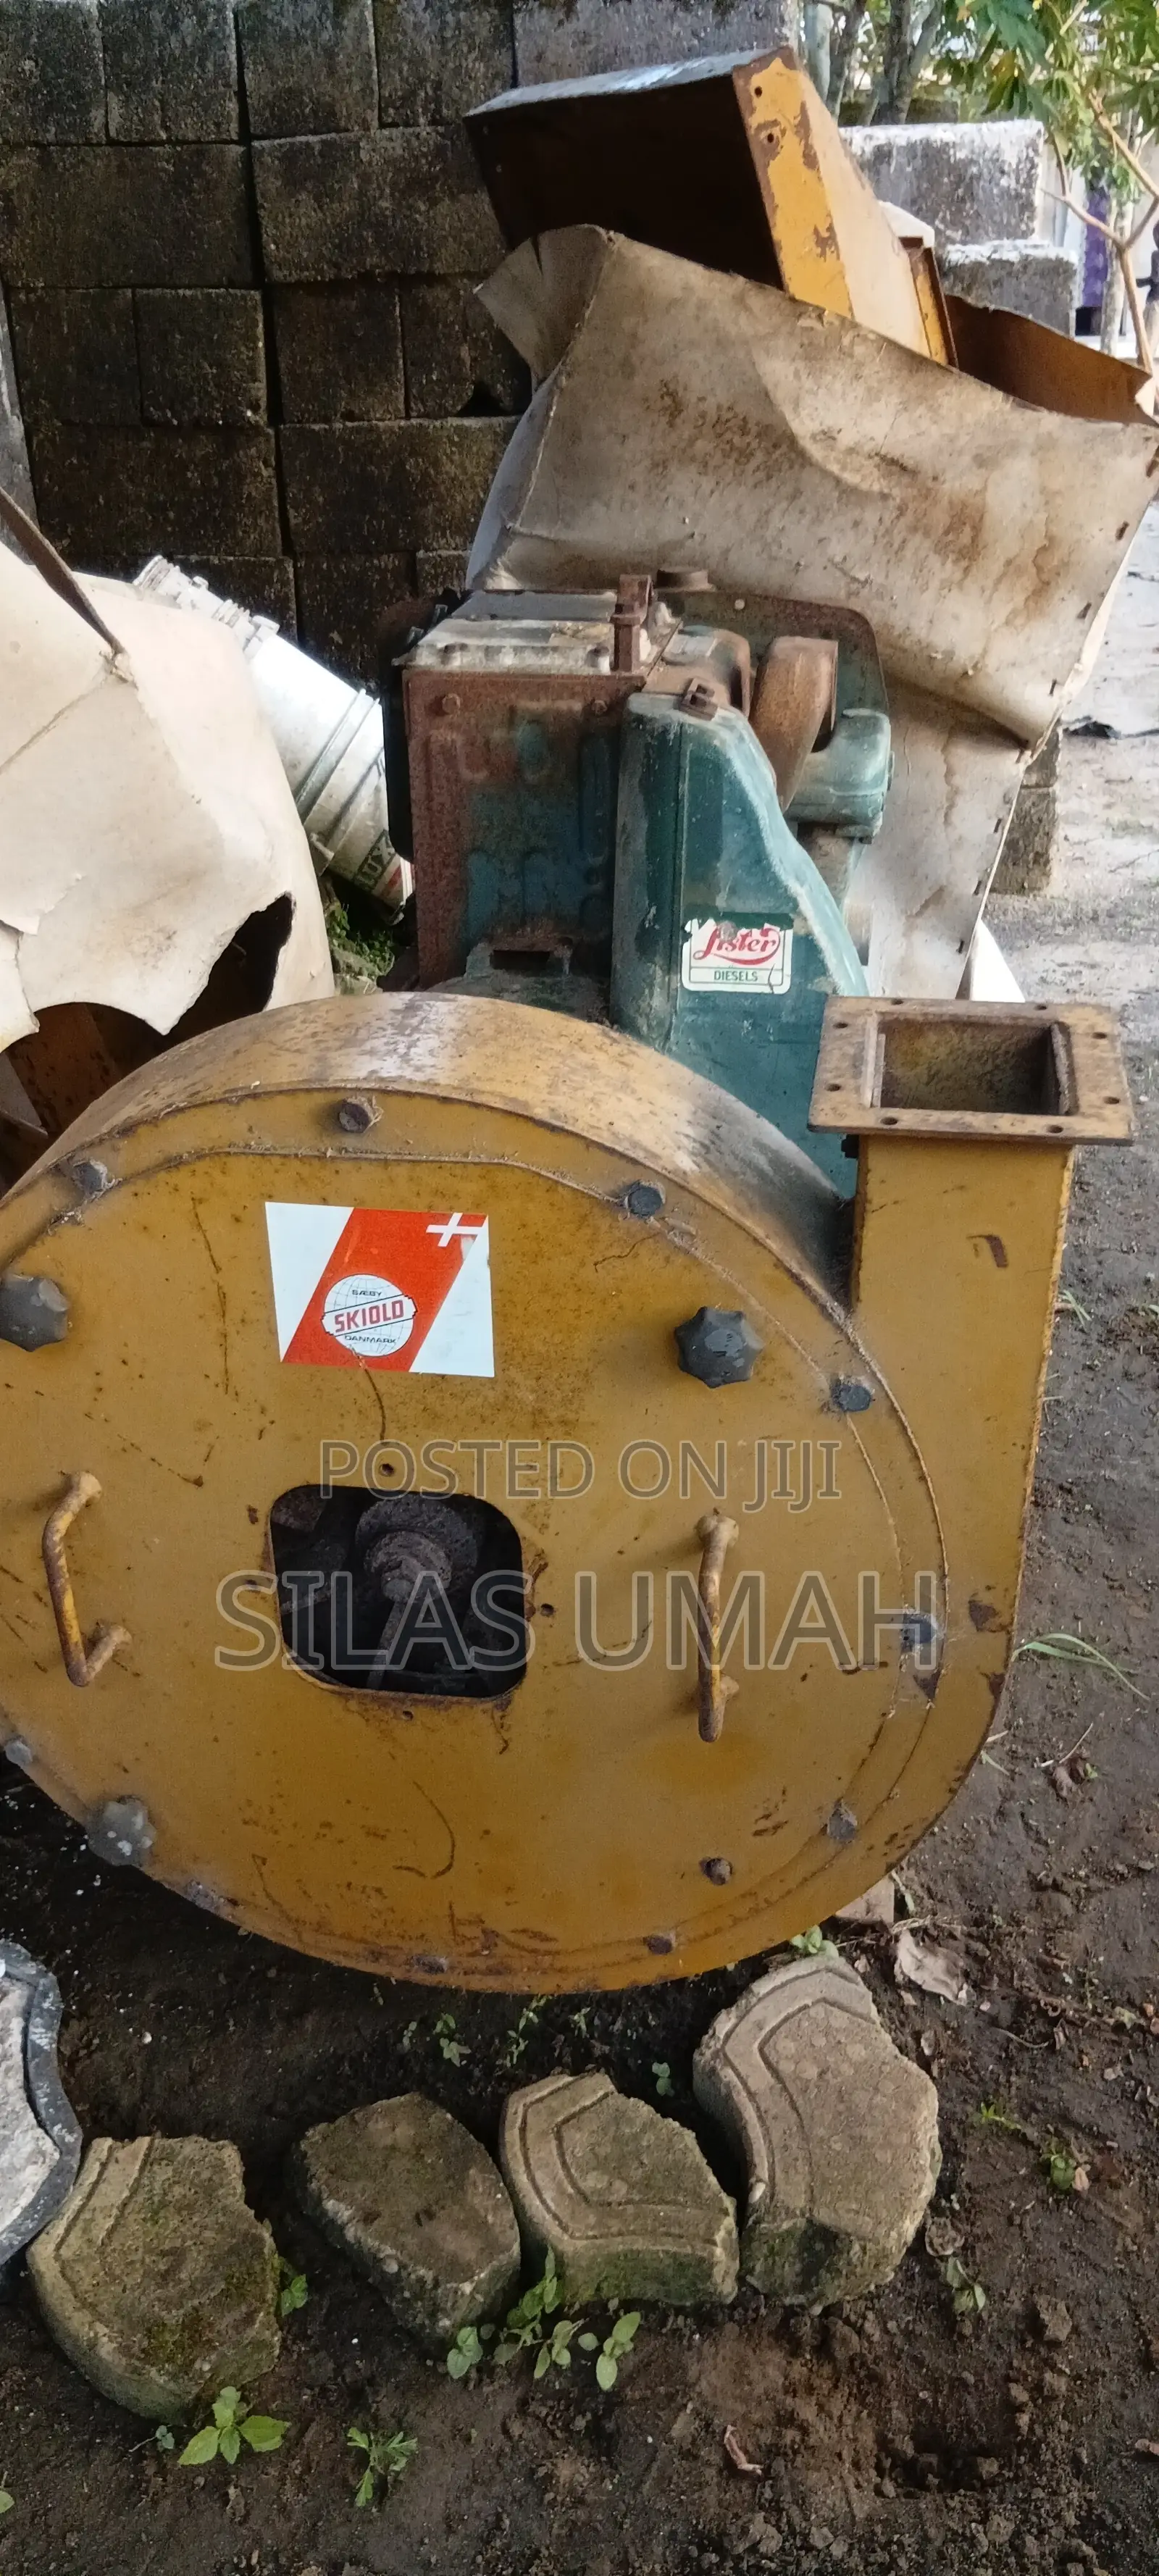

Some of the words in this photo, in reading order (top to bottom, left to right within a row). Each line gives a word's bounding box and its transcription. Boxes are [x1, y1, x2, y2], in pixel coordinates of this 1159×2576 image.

[714, 970, 758, 982] DIESELS
[334, 1300, 404, 1333] SKIOLD
[344, 1335, 396, 1344] DANMARK
